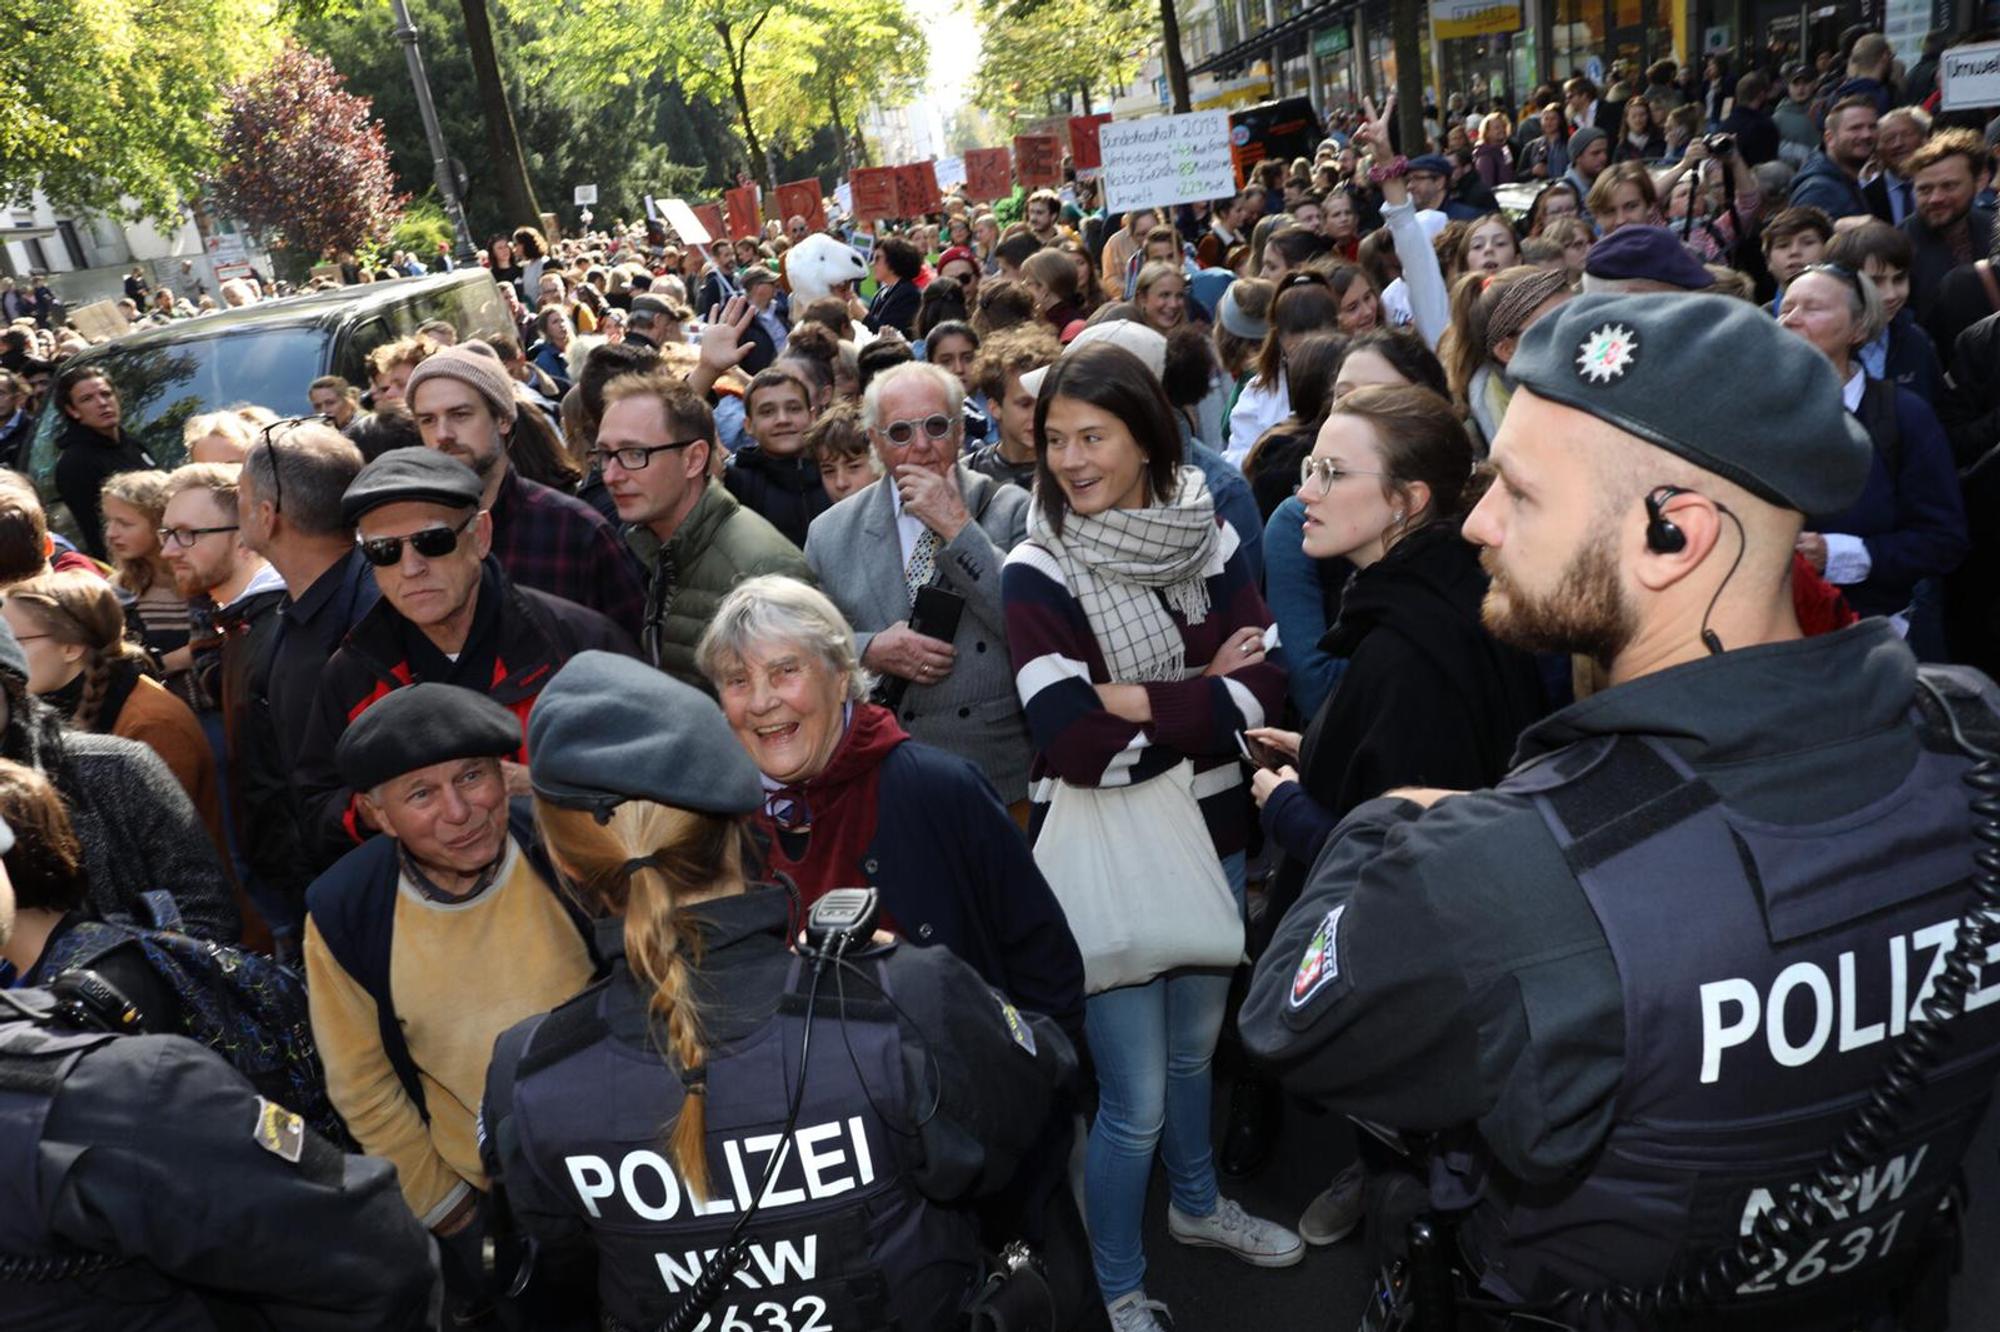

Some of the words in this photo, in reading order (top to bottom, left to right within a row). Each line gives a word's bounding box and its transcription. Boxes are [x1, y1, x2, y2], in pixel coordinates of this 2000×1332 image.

[565, 1116, 874, 1221] POLIZEI
[1736, 1211, 1905, 1293] 2631
[692, 1295, 833, 1332] 632
